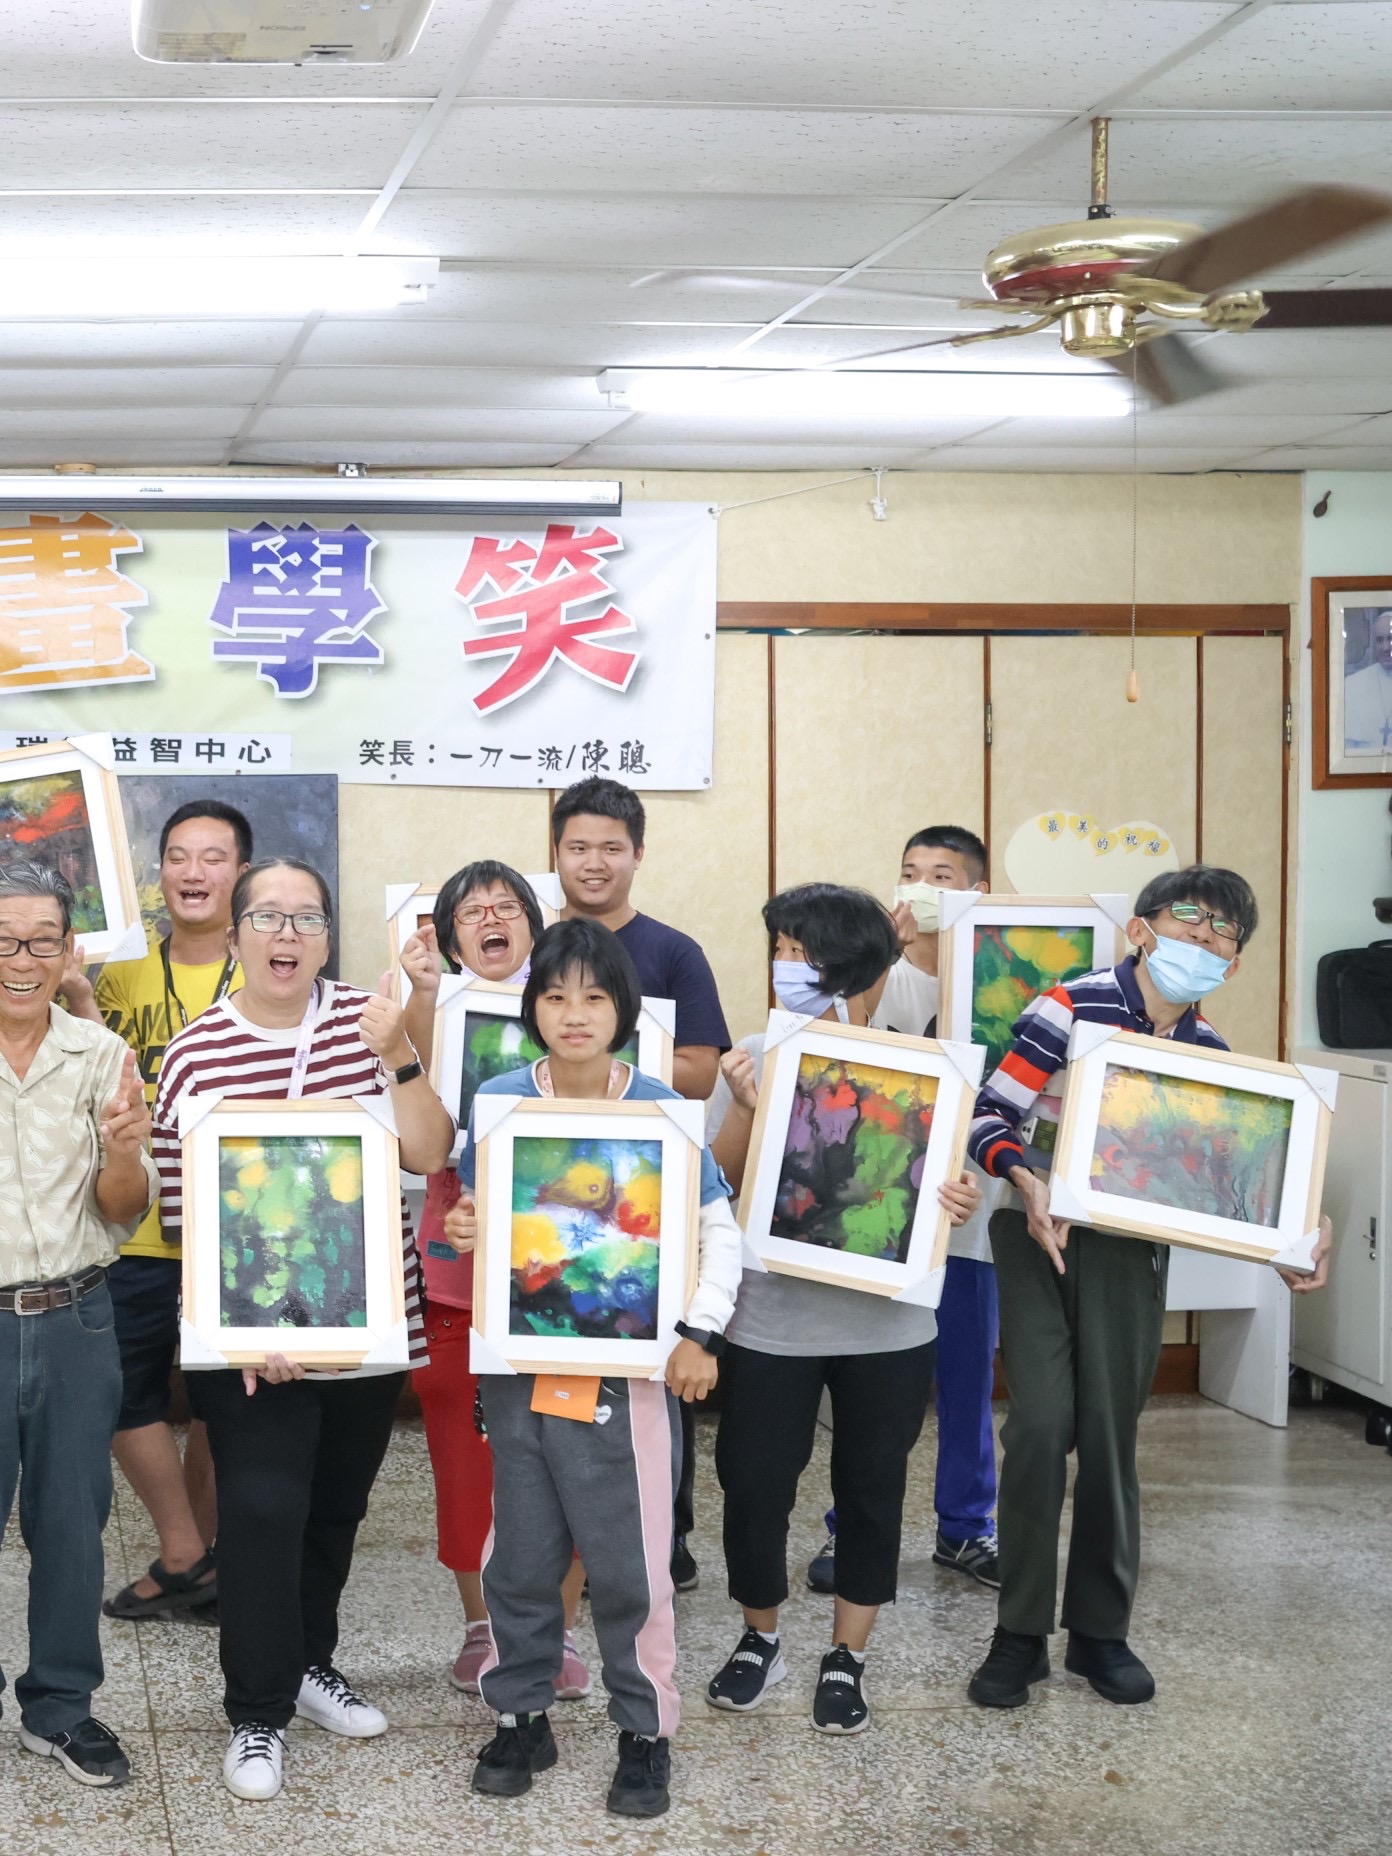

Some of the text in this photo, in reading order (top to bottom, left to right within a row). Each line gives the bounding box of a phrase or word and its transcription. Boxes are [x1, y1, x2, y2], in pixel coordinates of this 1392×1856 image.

[1048, 819, 1160, 853] 最美的祝福
[732, 1651, 764, 1667] PUMA
[822, 1671, 855, 1686] PUMA
